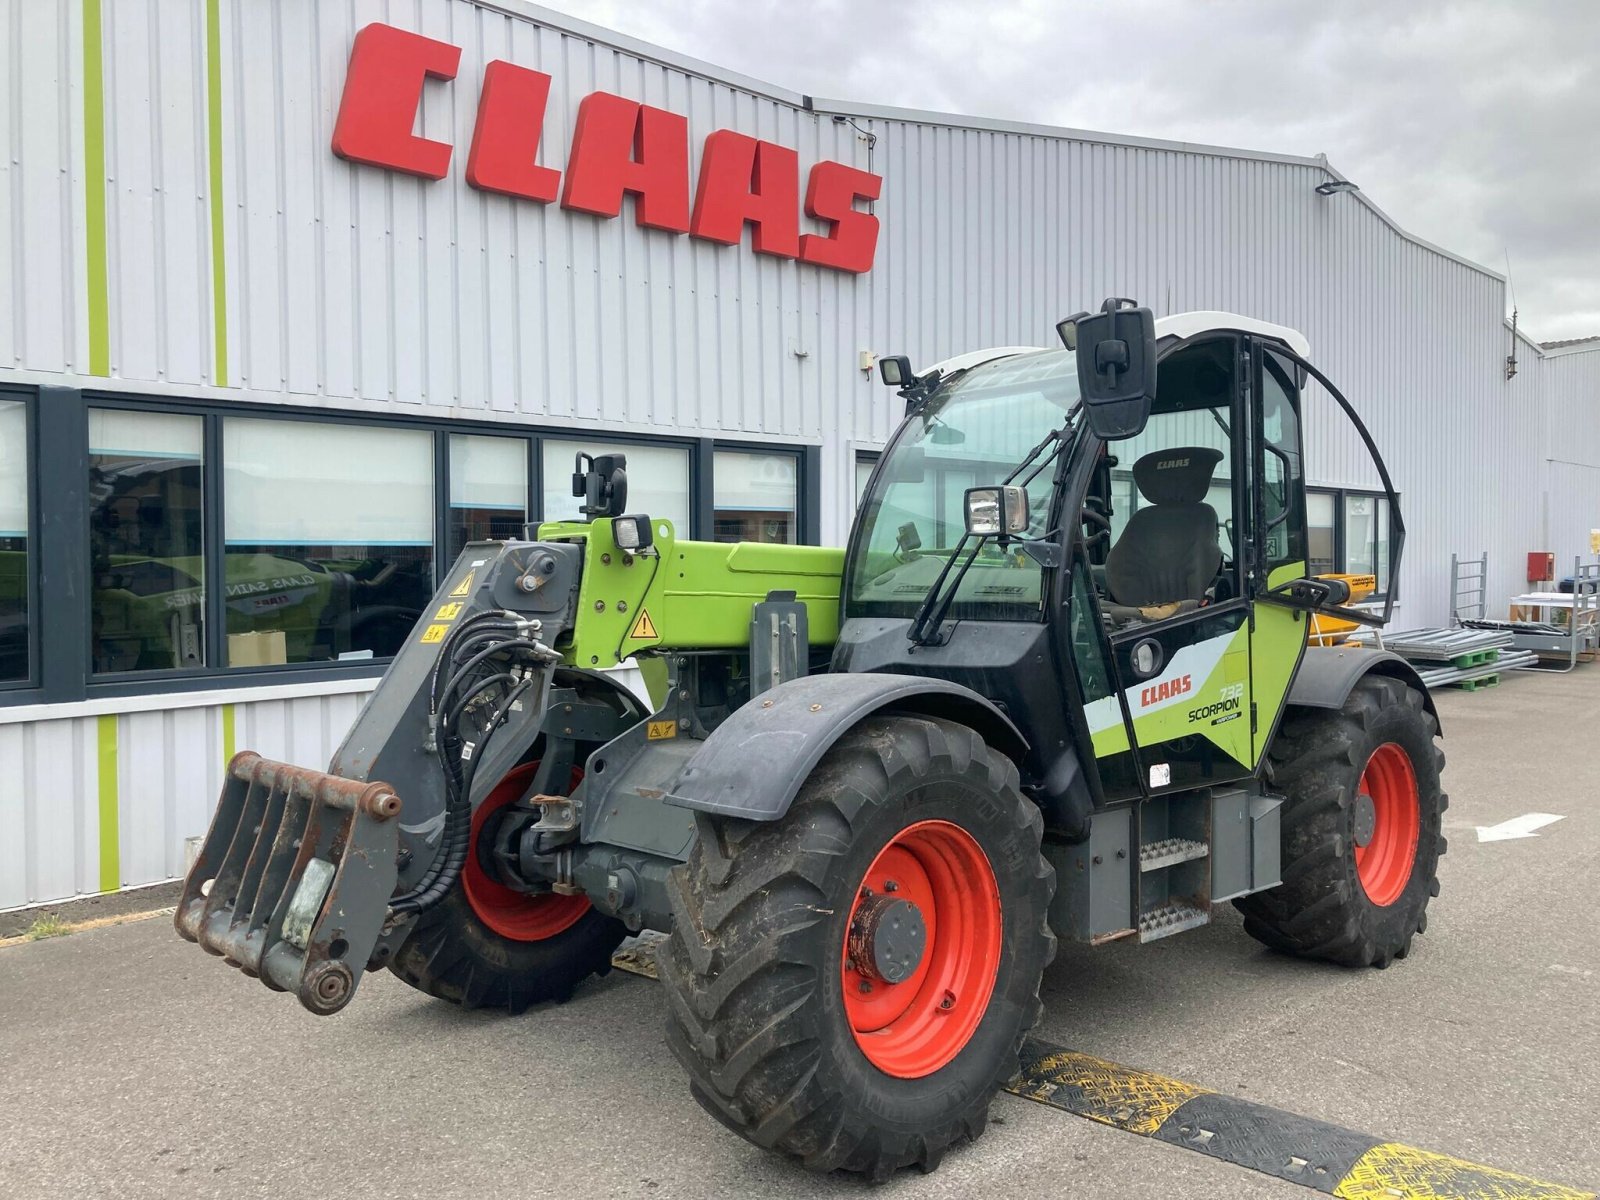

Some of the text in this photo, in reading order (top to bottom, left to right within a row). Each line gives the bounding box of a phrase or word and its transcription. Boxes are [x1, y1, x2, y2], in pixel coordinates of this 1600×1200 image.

[331, 22, 883, 274] CLAAS
[1157, 458, 1190, 470] CLAAS
[1141, 674, 1192, 707] CLAAS
[1219, 683, 1244, 700] 732
[1188, 697, 1240, 723] SCORPION
